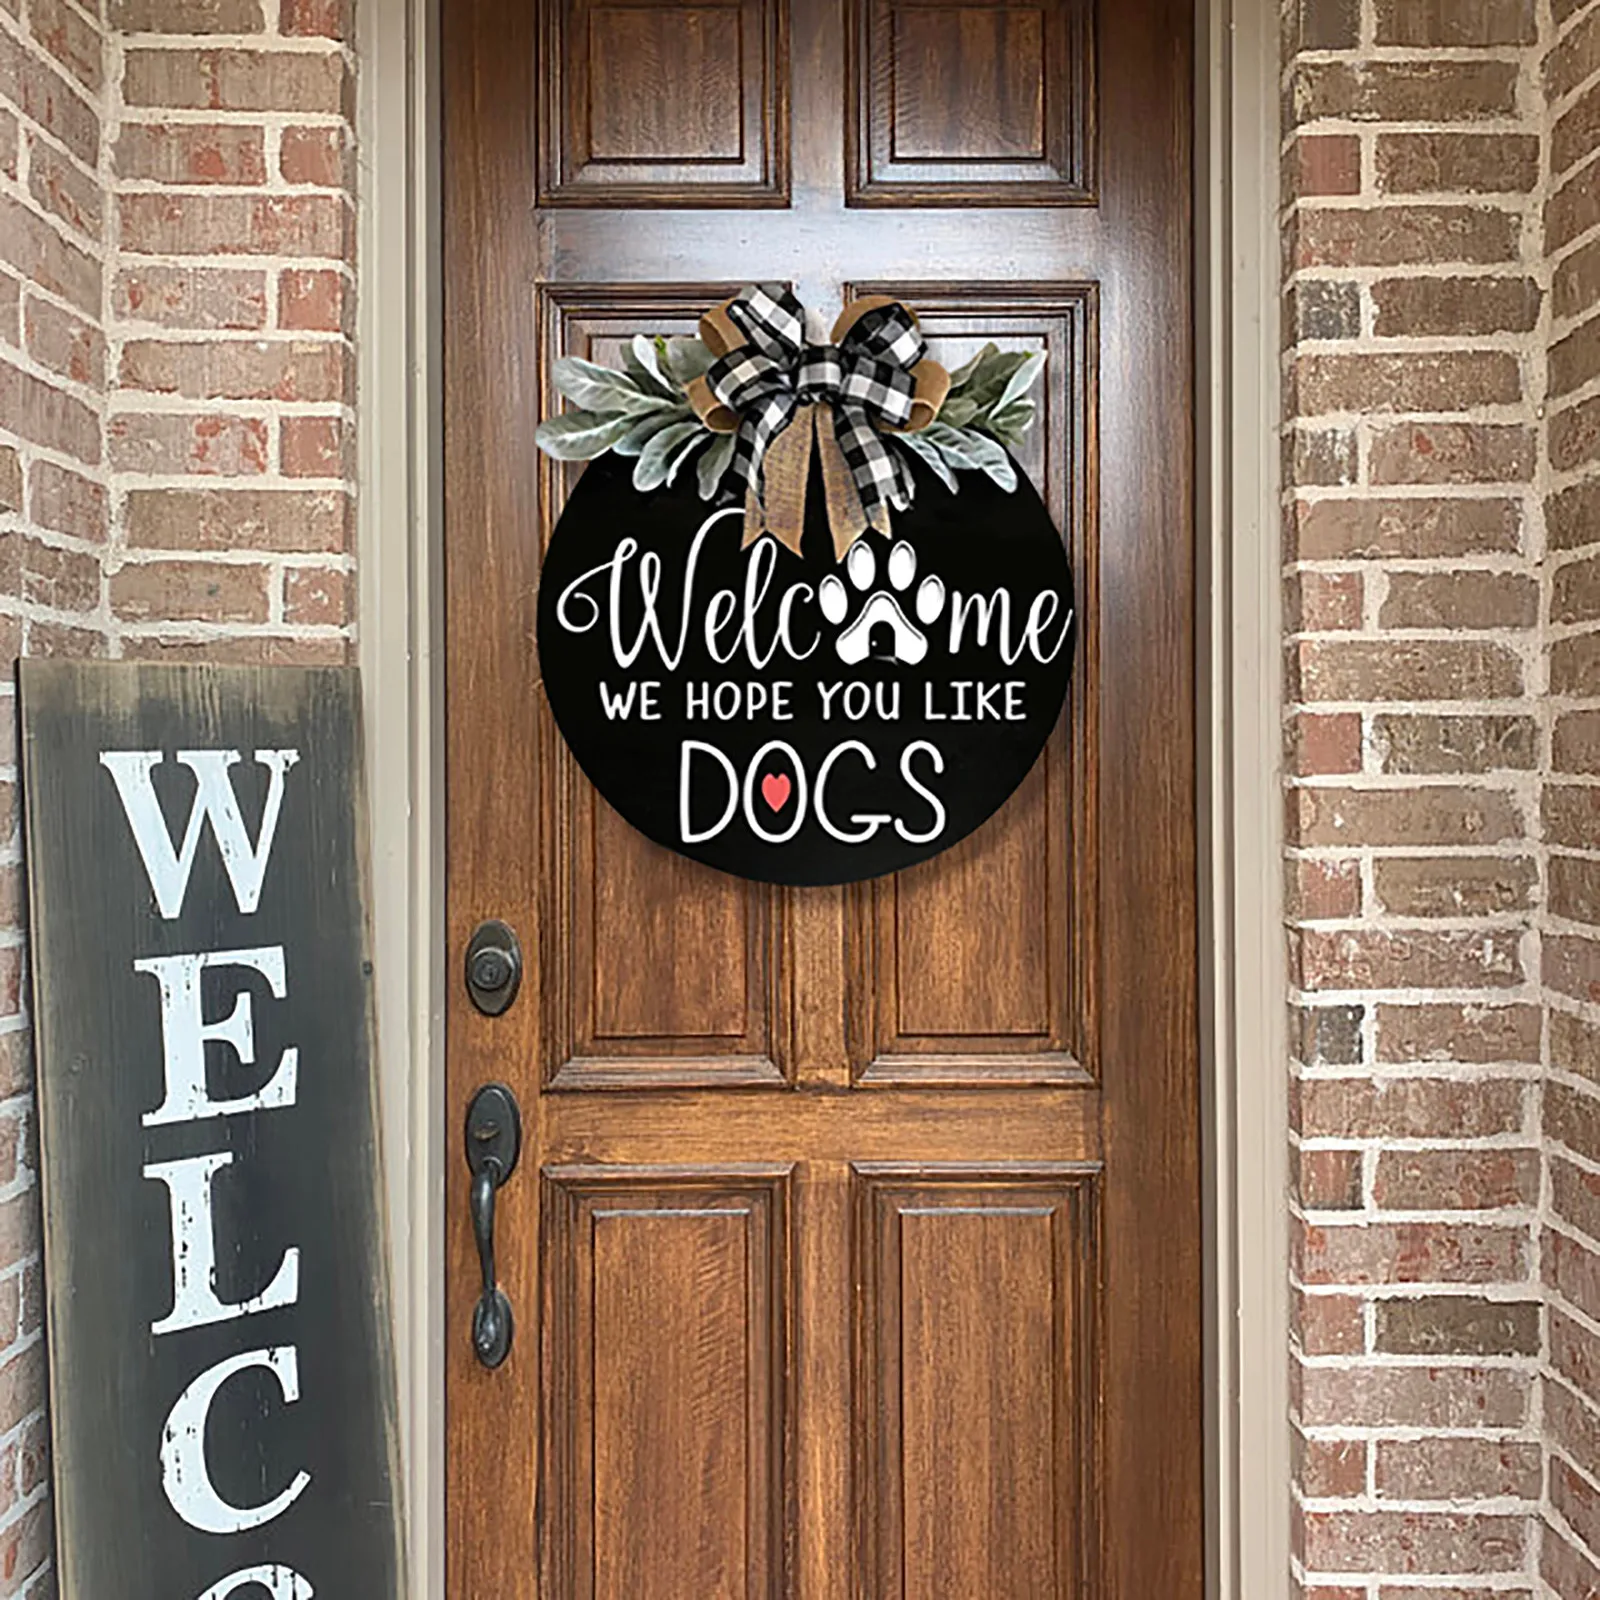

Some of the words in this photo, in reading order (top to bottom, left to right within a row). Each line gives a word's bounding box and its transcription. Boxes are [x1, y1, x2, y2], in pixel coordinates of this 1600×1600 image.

[556, 507, 1073, 671] Welcme
[599, 681, 662, 721] WE
[686, 680, 794, 721] HOPE
[817, 680, 900, 721] YOU
[925, 680, 1027, 721] LIKE
[680, 739, 946, 844] DOGS
[98, 748, 313, 1600] WELC
